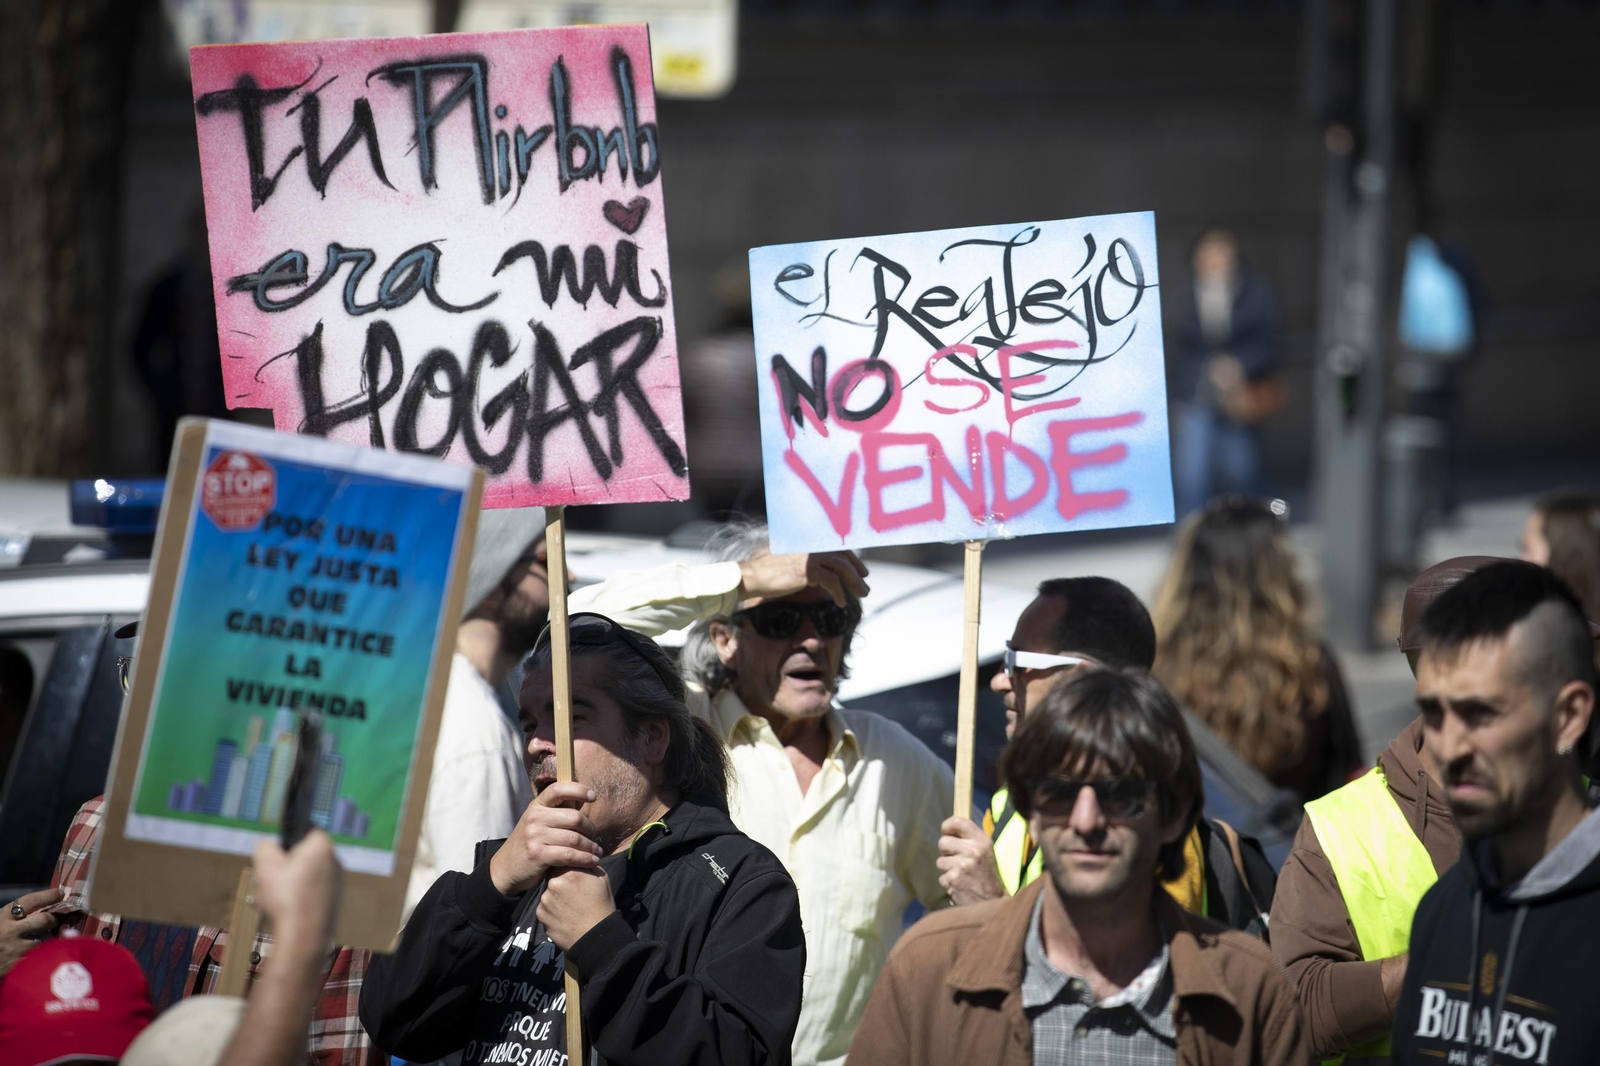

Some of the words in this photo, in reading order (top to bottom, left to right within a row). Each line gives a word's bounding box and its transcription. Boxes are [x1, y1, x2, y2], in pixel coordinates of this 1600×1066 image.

[226, 238, 501, 315] era
[492, 196, 668, 310] mi
[255, 317, 687, 483] HOGAR
[771, 345, 902, 438] NO
[924, 339, 1081, 426] SE
[205, 469, 272, 496] STOP
[784, 411, 1145, 538] VENDE
[262, 511, 328, 542] POR
[336, 524, 397, 554] UNA
[246, 543, 302, 573] LEY
[309, 557, 399, 588] JUSTA
[288, 585, 347, 615] QUE
[225, 608, 396, 657] GARANTICE
[284, 653, 321, 679] LA
[226, 679, 367, 721] VIVIENDA
[479, 976, 510, 1004] OS
[500, 1010, 553, 1041] PRQUE
